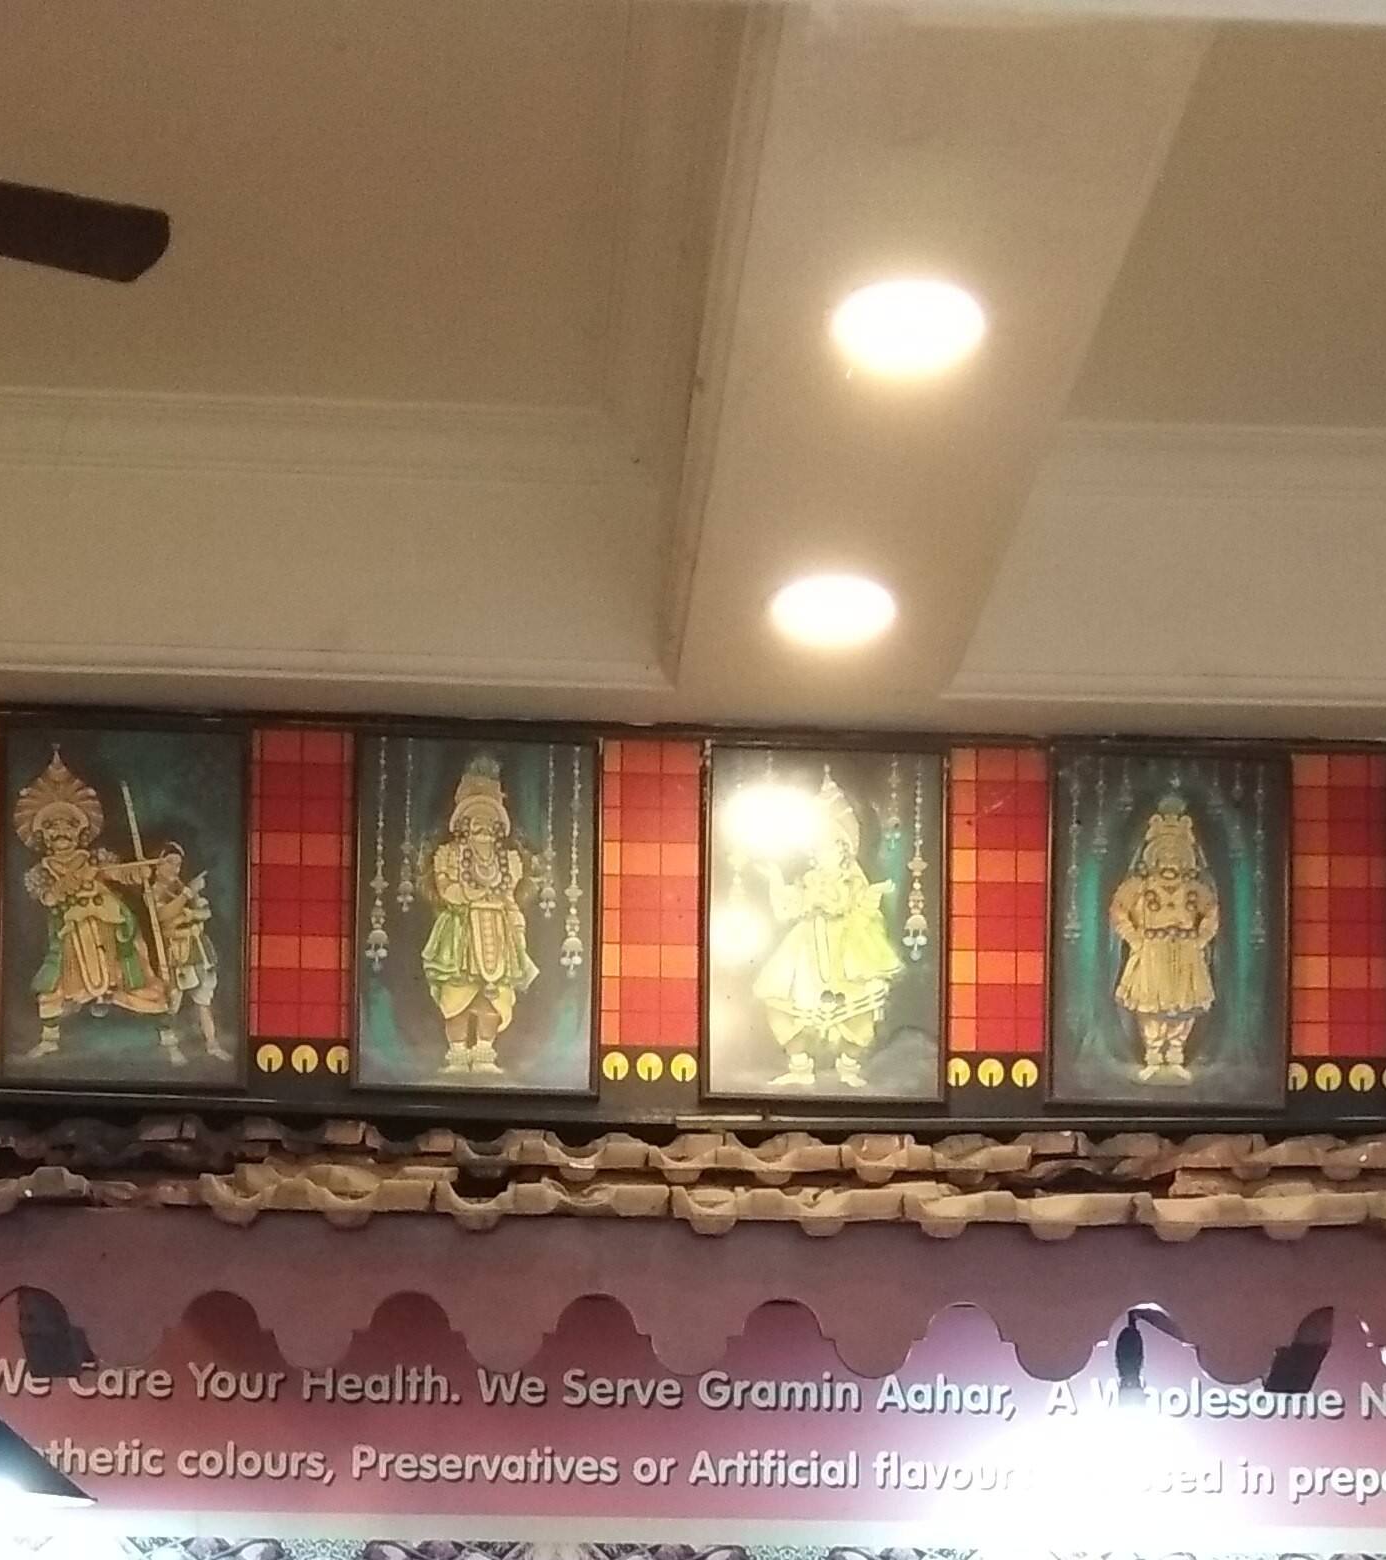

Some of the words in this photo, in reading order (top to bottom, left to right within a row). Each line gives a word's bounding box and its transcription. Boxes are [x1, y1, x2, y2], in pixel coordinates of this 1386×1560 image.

[67, 1360, 173, 1398] Care
[187, 1361, 285, 1400] Your
[302, 1363, 461, 1405] Health.
[476, 1368, 546, 1406] We
[562, 1368, 684, 1406] Serve
[698, 1370, 860, 1412] Gramin
[876, 1373, 1018, 1420] Aahar,
[1047, 1380, 1078, 1415] A
[31, 1436, 166, 1477] thetic
[176, 1440, 335, 1484] colours,
[351, 1443, 620, 1483] Preservatives
[632, 1455, 678, 1484] or
[688, 1449, 859, 1488] Artificial
[871, 1451, 1034, 1493] flavour
[1137, 1456, 1226, 1495] sed
[1238, 1456, 1275, 1495] in
